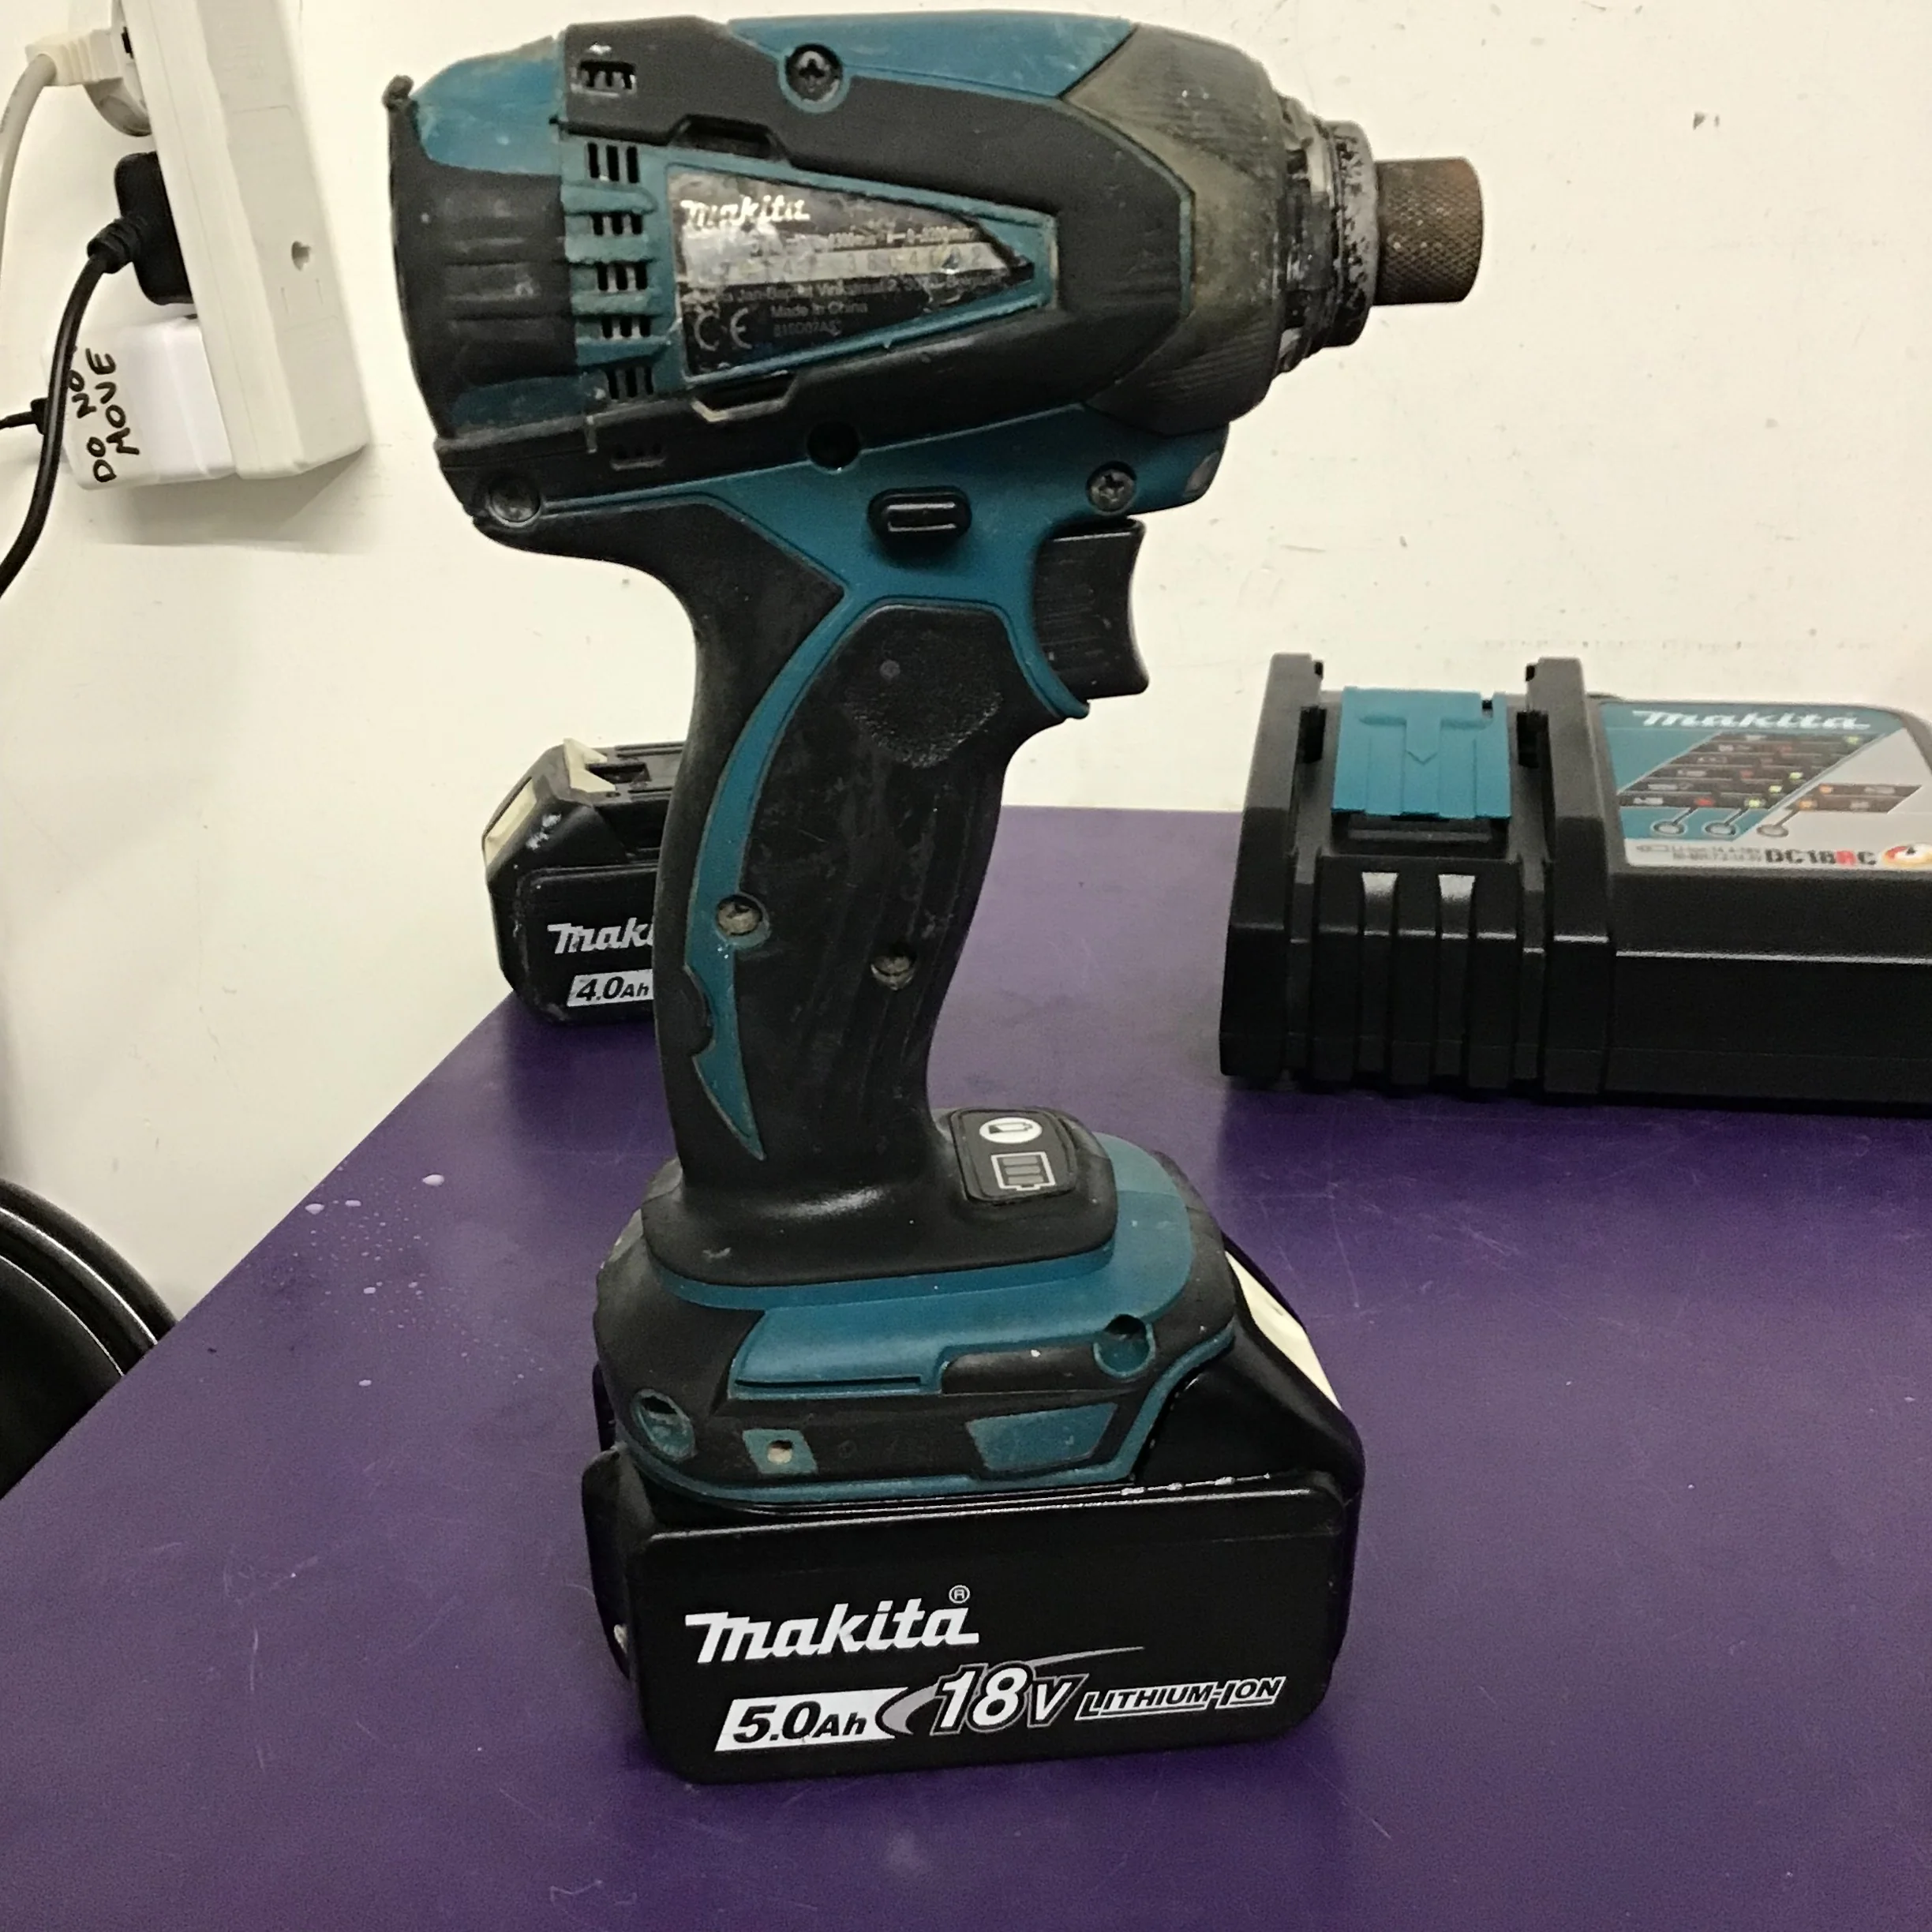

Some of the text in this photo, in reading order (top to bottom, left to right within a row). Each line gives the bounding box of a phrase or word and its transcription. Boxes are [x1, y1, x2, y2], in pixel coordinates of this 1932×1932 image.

[69, 345, 117, 482] DO NO
[85, 347, 140, 455] MOVE
[1764, 848, 1878, 867] DC18RC
[576, 976, 650, 1002] 4.0Ah
[733, 1701, 867, 1743] 5.0Ah
[930, 1660, 1090, 1736] 18V
